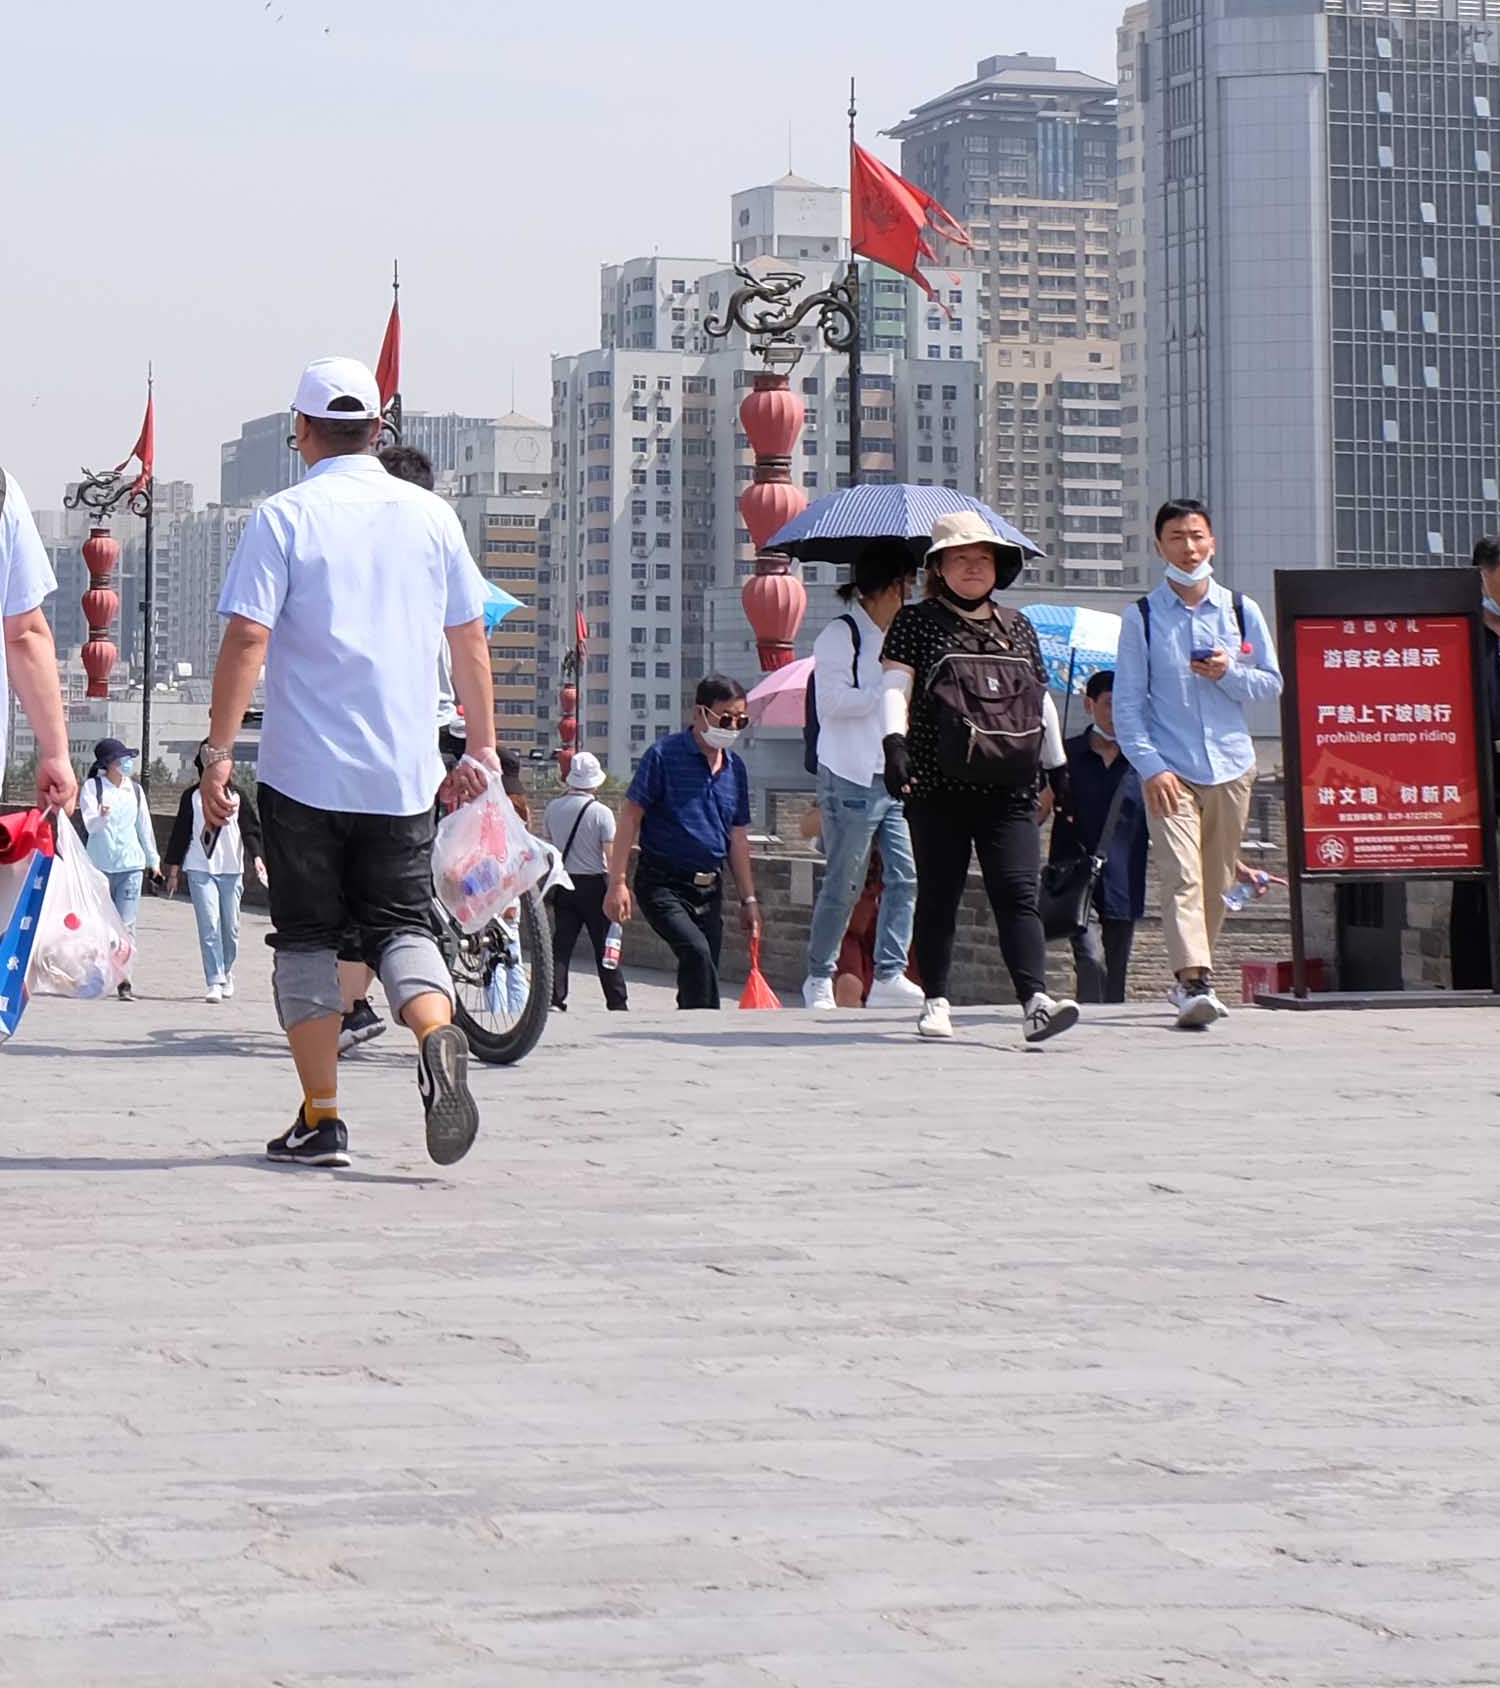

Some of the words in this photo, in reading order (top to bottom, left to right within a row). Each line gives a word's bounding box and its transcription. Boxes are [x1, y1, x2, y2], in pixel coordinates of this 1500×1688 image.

[1323, 648, 1441, 668] 游客安全提示
[1317, 703, 1453, 724] 严禁上下坡骑行
[1316, 731, 1382, 746] prohibited
[1384, 732, 1417, 744] ramp
[1419, 729, 1457, 744] riding
[1318, 786, 1378, 805] 讲文明
[1400, 785, 1462, 803] 树新风
